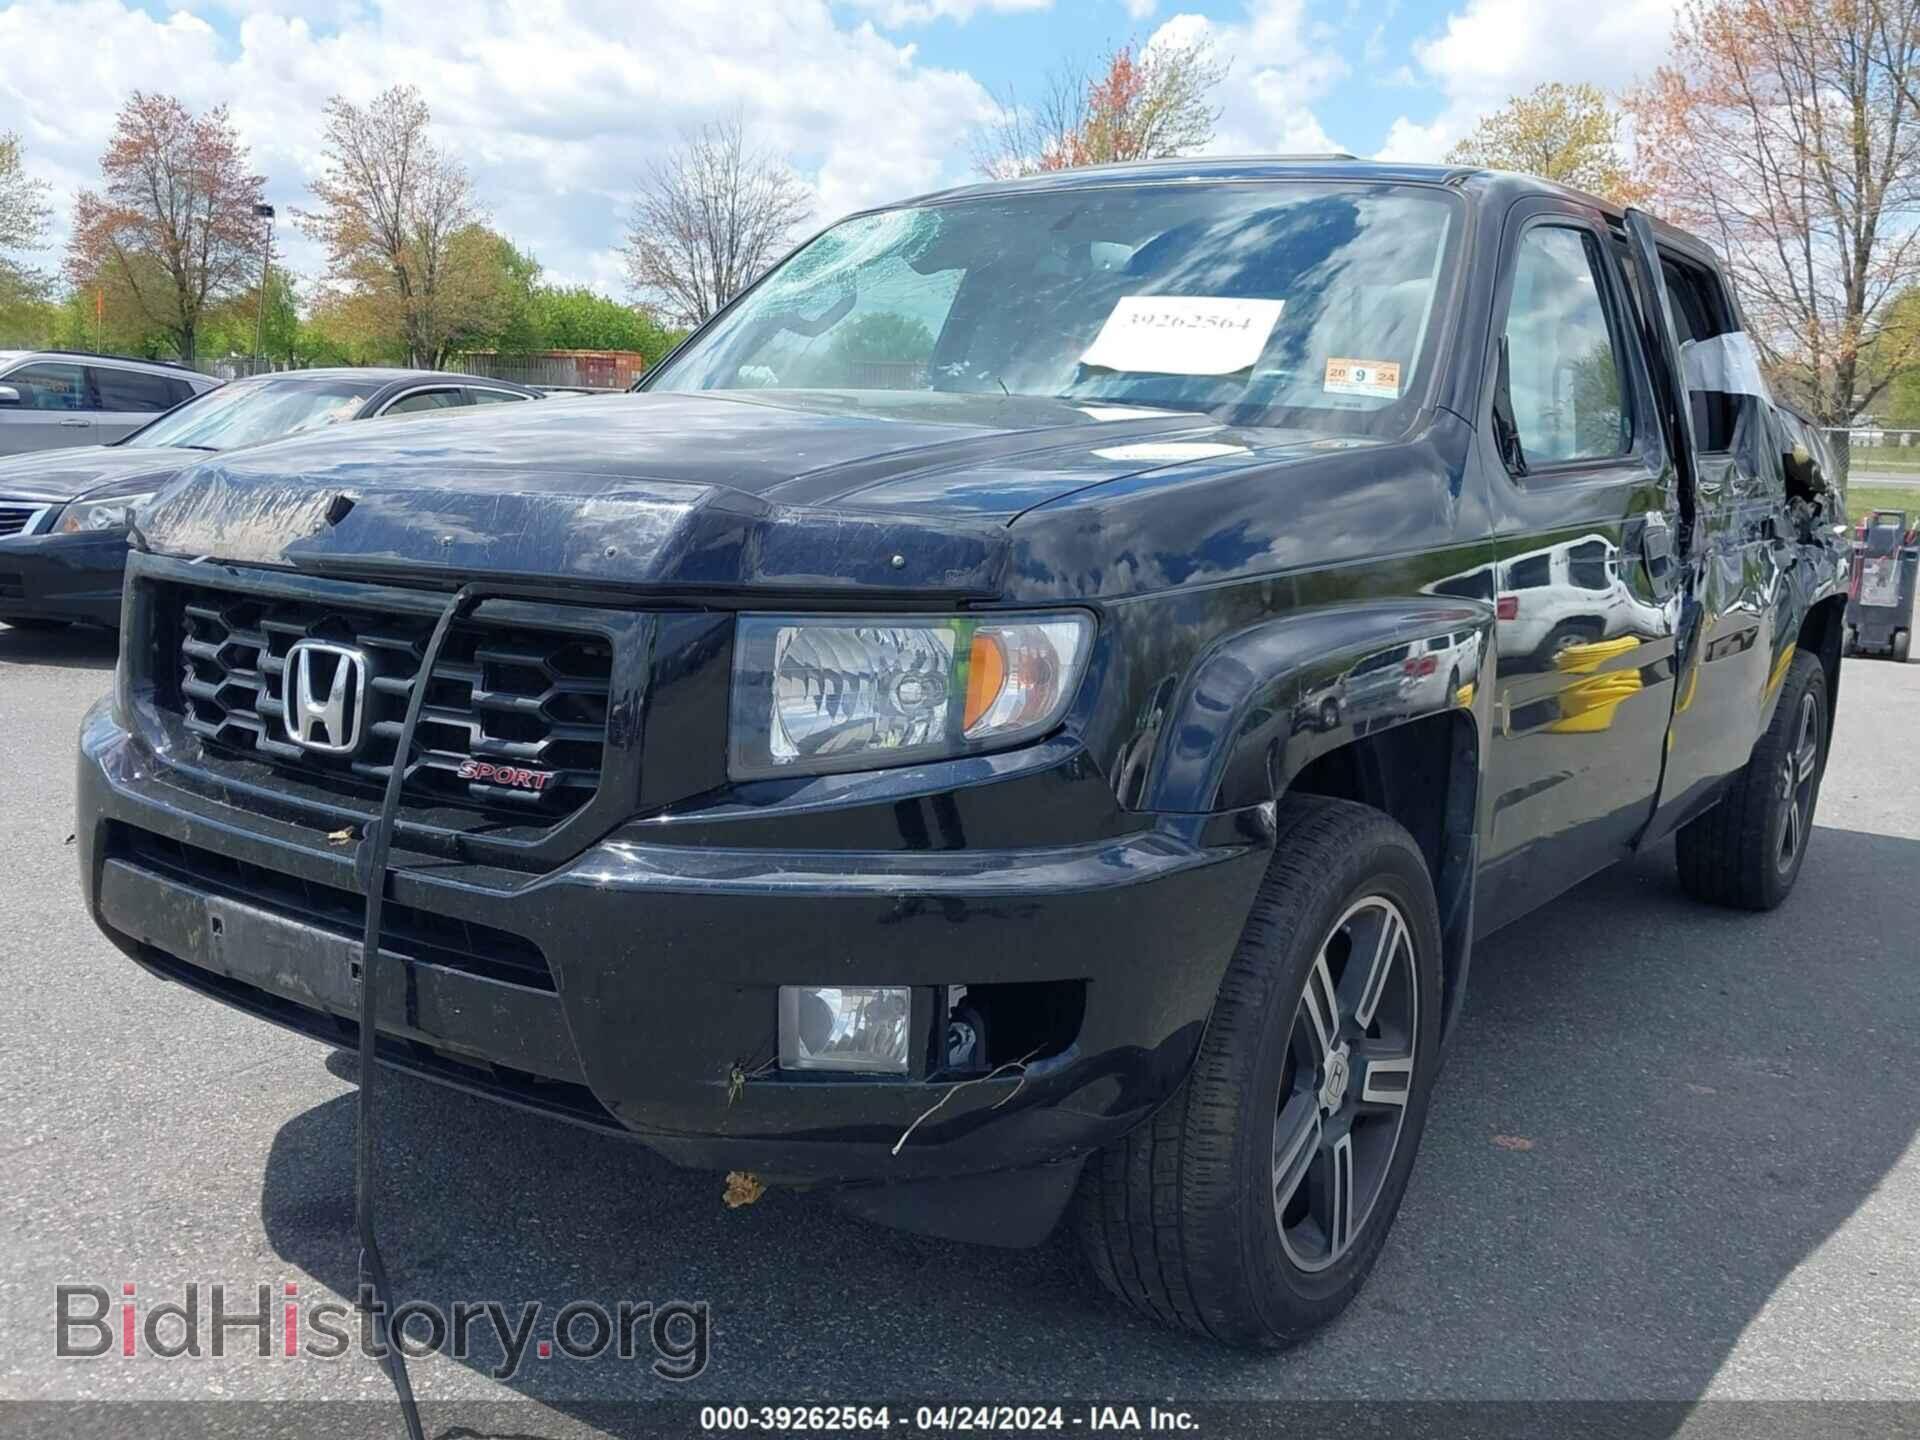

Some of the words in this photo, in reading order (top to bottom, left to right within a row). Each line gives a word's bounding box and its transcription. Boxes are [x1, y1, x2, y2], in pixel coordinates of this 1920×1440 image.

[1329, 367, 1346, 378] 20
[1355, 368, 1366, 382] 9
[1378, 372, 1395, 382] 24
[457, 760, 553, 789] SPORT
